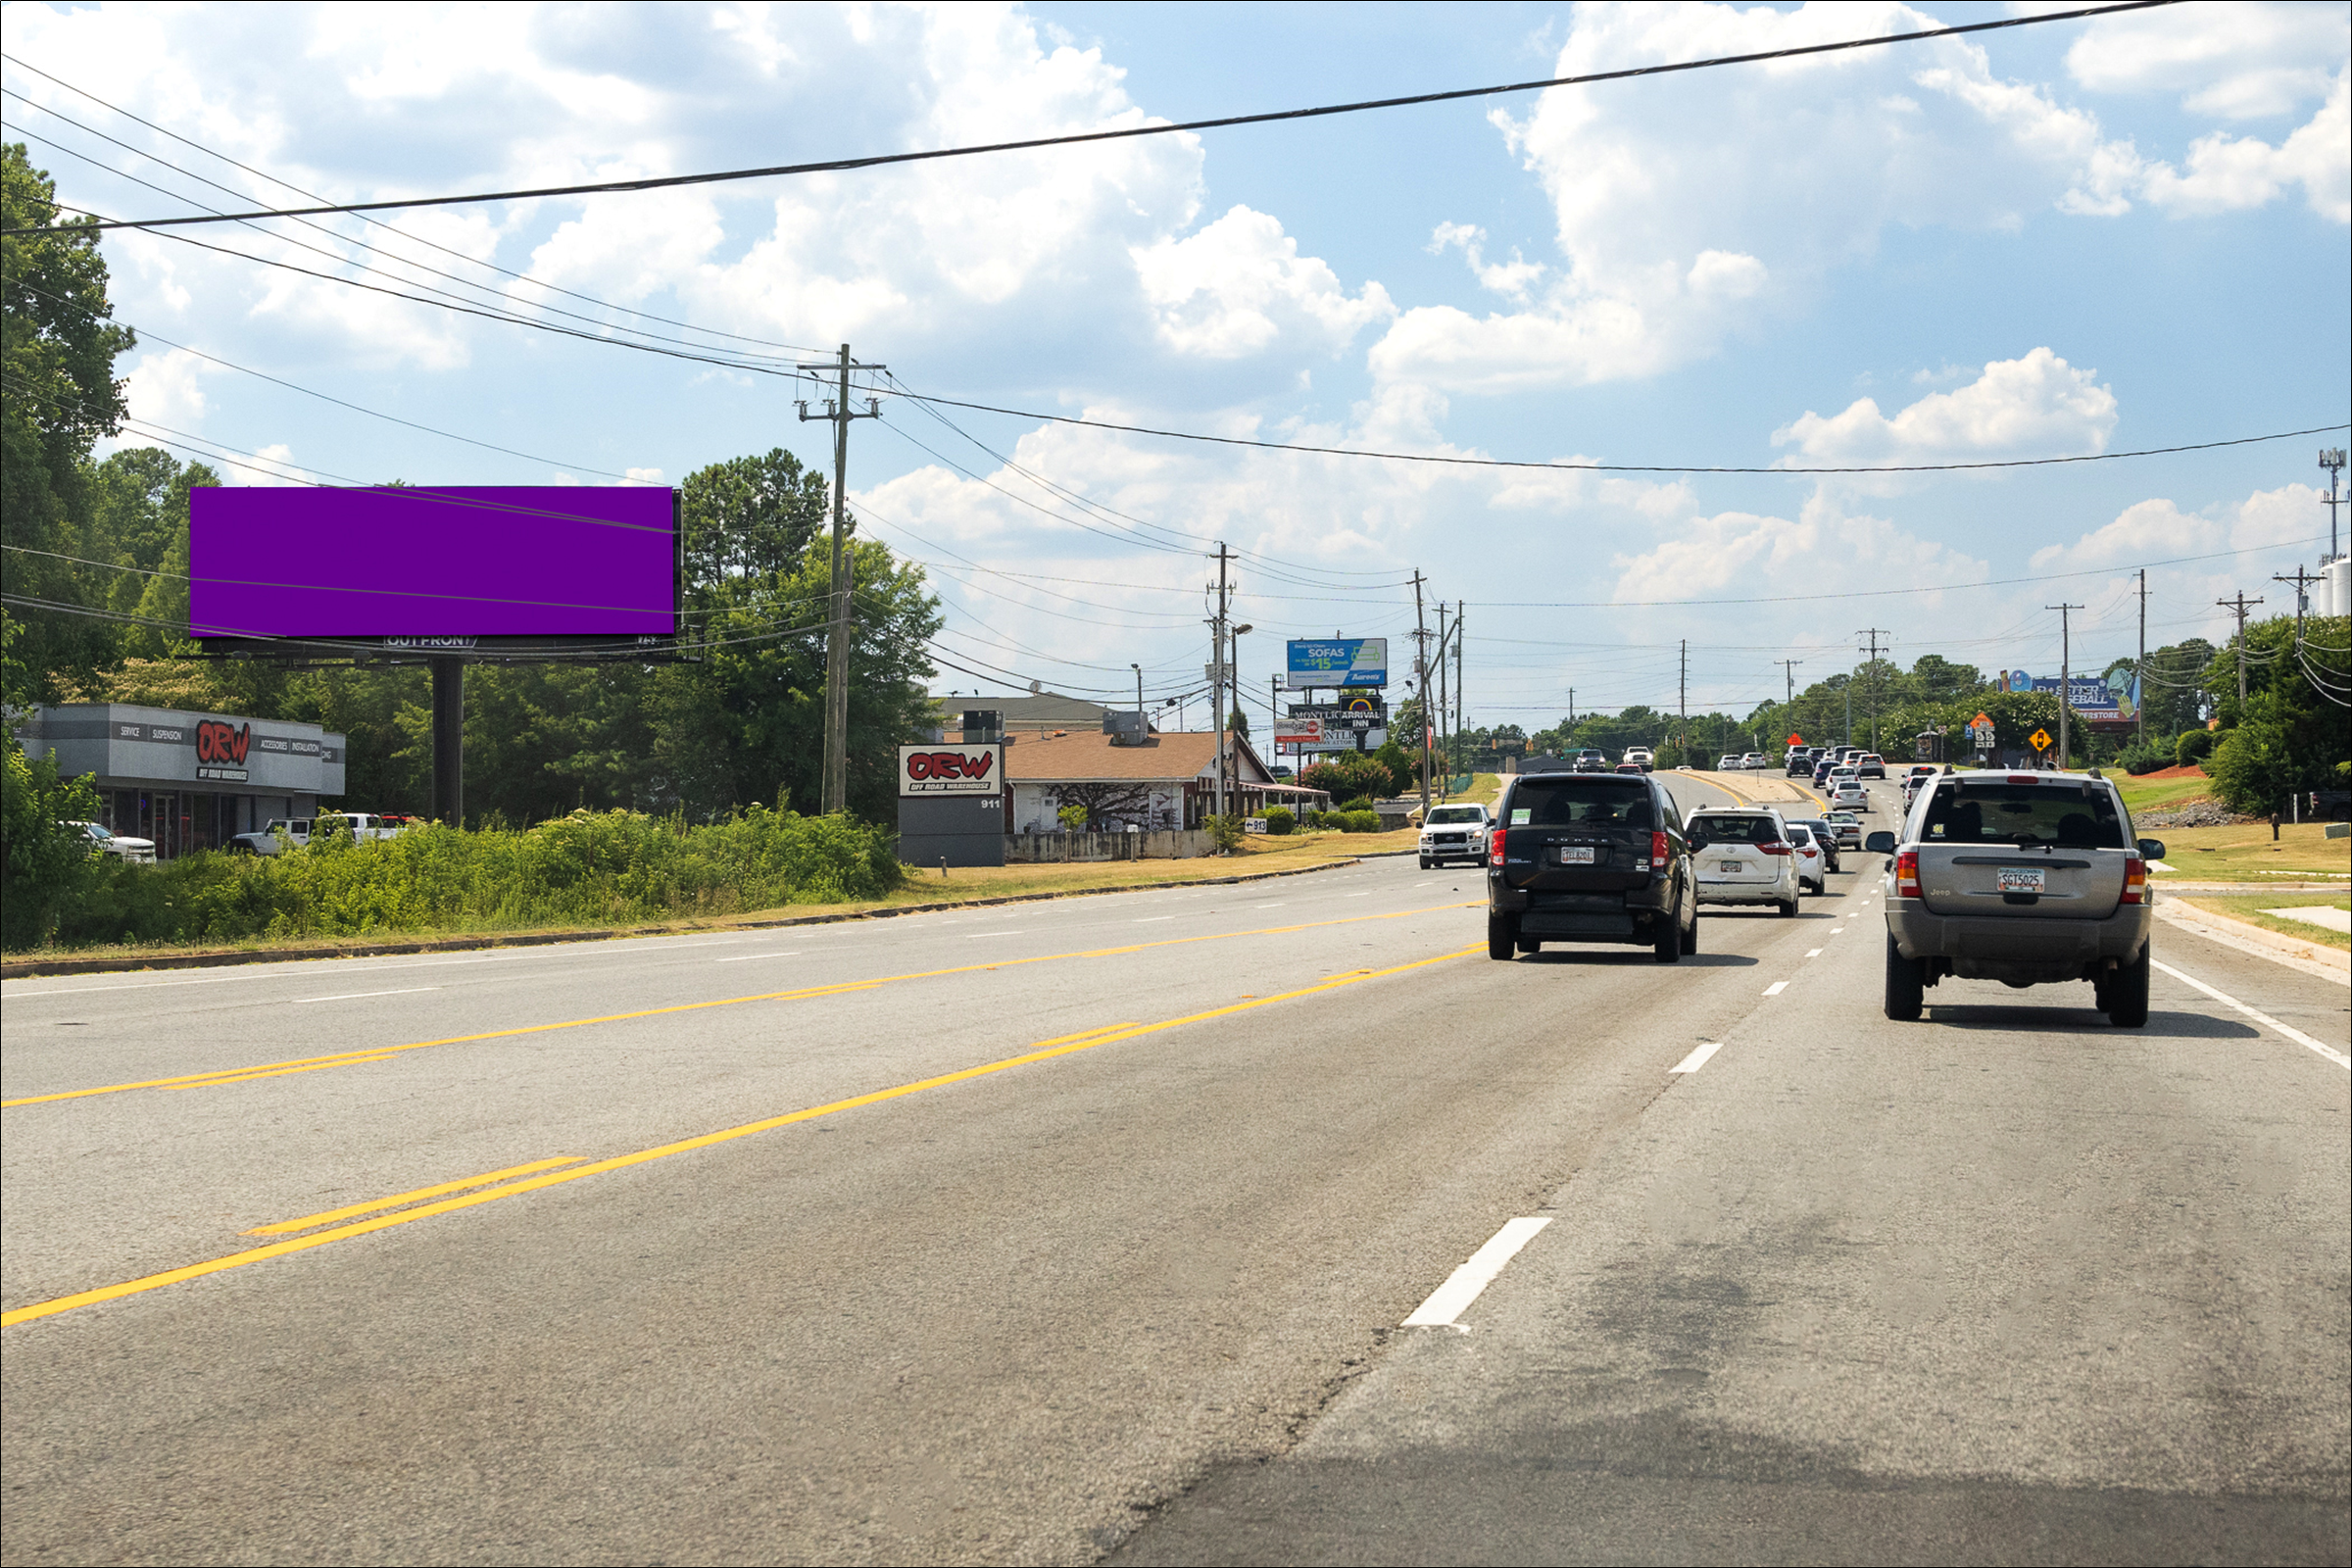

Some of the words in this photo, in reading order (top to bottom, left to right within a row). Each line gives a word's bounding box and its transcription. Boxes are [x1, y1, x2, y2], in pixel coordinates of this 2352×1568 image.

[1308, 648, 1345, 658] SOFAS
[1342, 710, 1381, 719] ARRIVAL
[121, 726, 140, 737] SERVICE
[152, 729, 182, 741] SUSPENSION
[197, 719, 250, 765] ORW
[292, 742, 319, 753] INSTALLATION
[907, 751, 993, 780] ORW
[199, 768, 208, 777] OFF
[208, 769, 221, 778] ROAD
[221, 770, 248, 780] WAREHOUSE
[981, 800, 1000, 808] 911
[1254, 820, 1265, 830] 913
[2002, 874, 2039, 887] SGT5025
